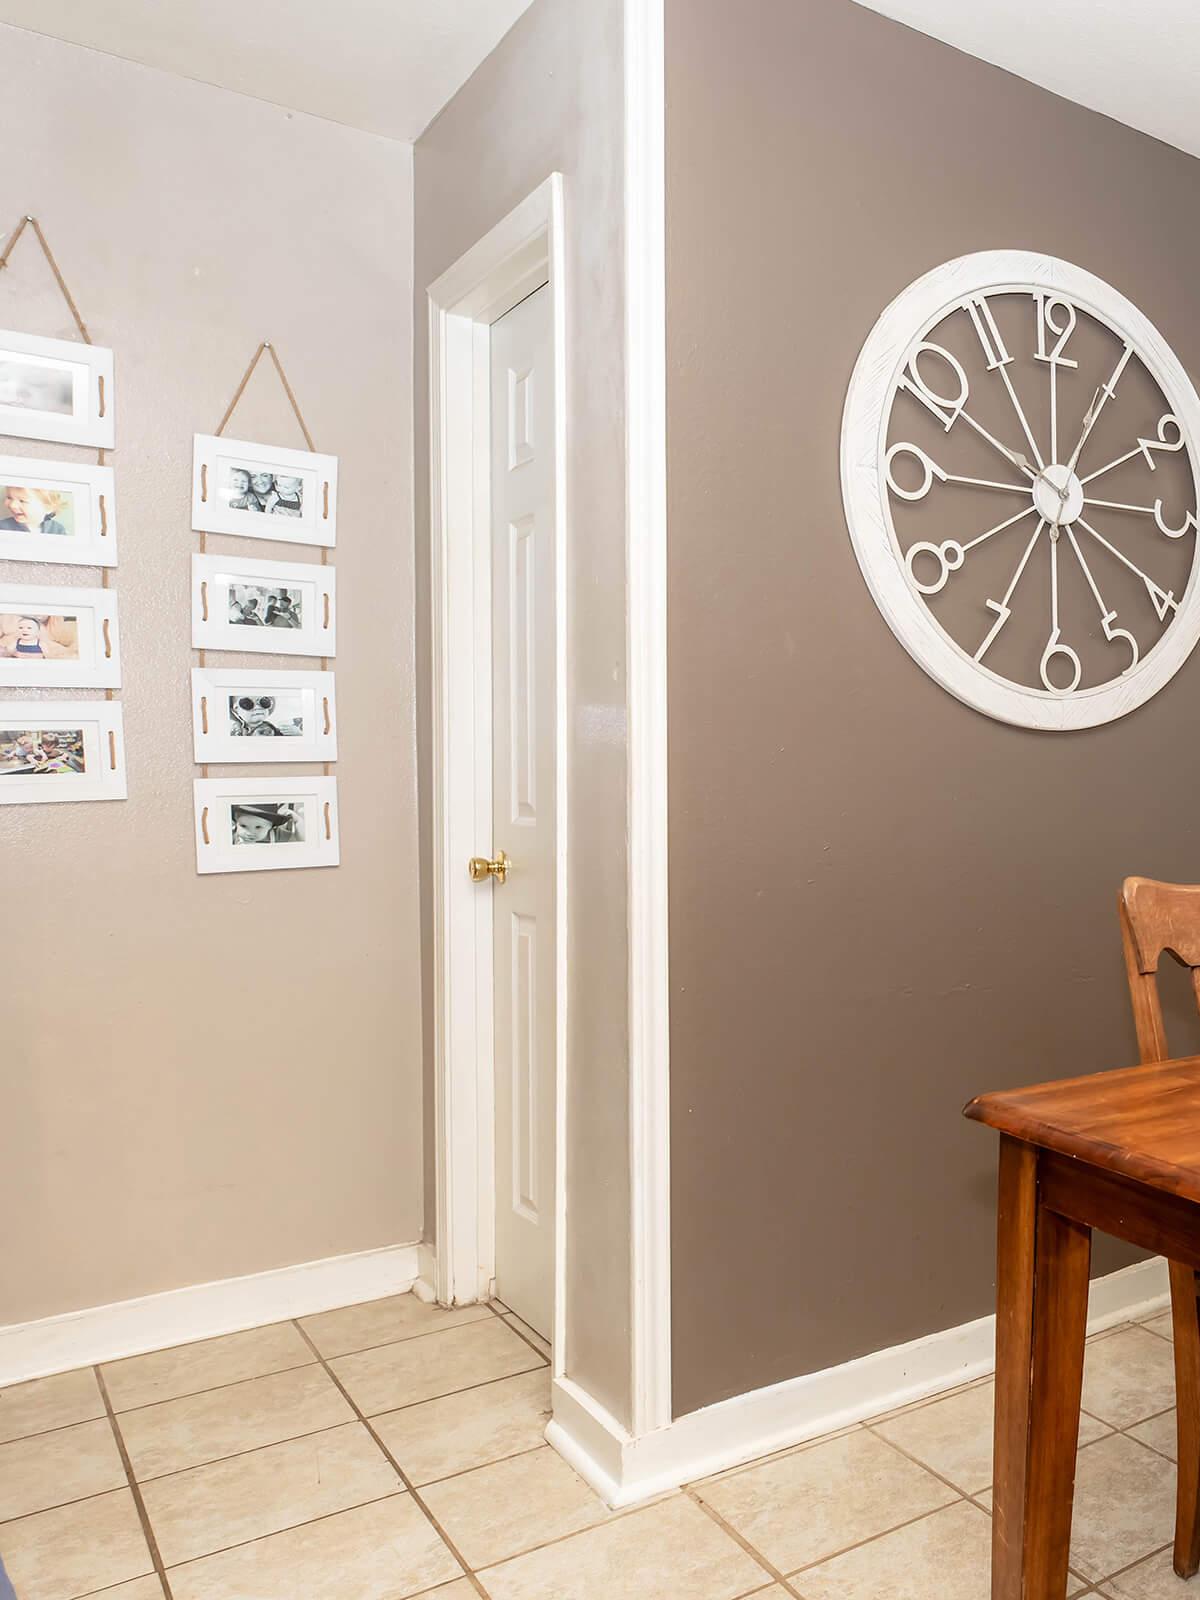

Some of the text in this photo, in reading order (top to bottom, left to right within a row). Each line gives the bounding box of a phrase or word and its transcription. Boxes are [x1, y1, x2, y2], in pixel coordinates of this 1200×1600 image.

[960, 296, 1014, 371] 11
[1032, 291, 1077, 367] 12
[896, 341, 968, 432] 10
[1102, 341, 1135, 399] 1
[885, 442, 948, 500] 9
[1137, 414, 1186, 471] 2
[1154, 499, 1199, 538] 3
[905, 540, 964, 594] 8
[1142, 573, 1182, 621] 4
[974, 598, 1011, 662] 7
[1040, 628, 1080, 693] 6
[1101, 610, 1139, 676] 5
